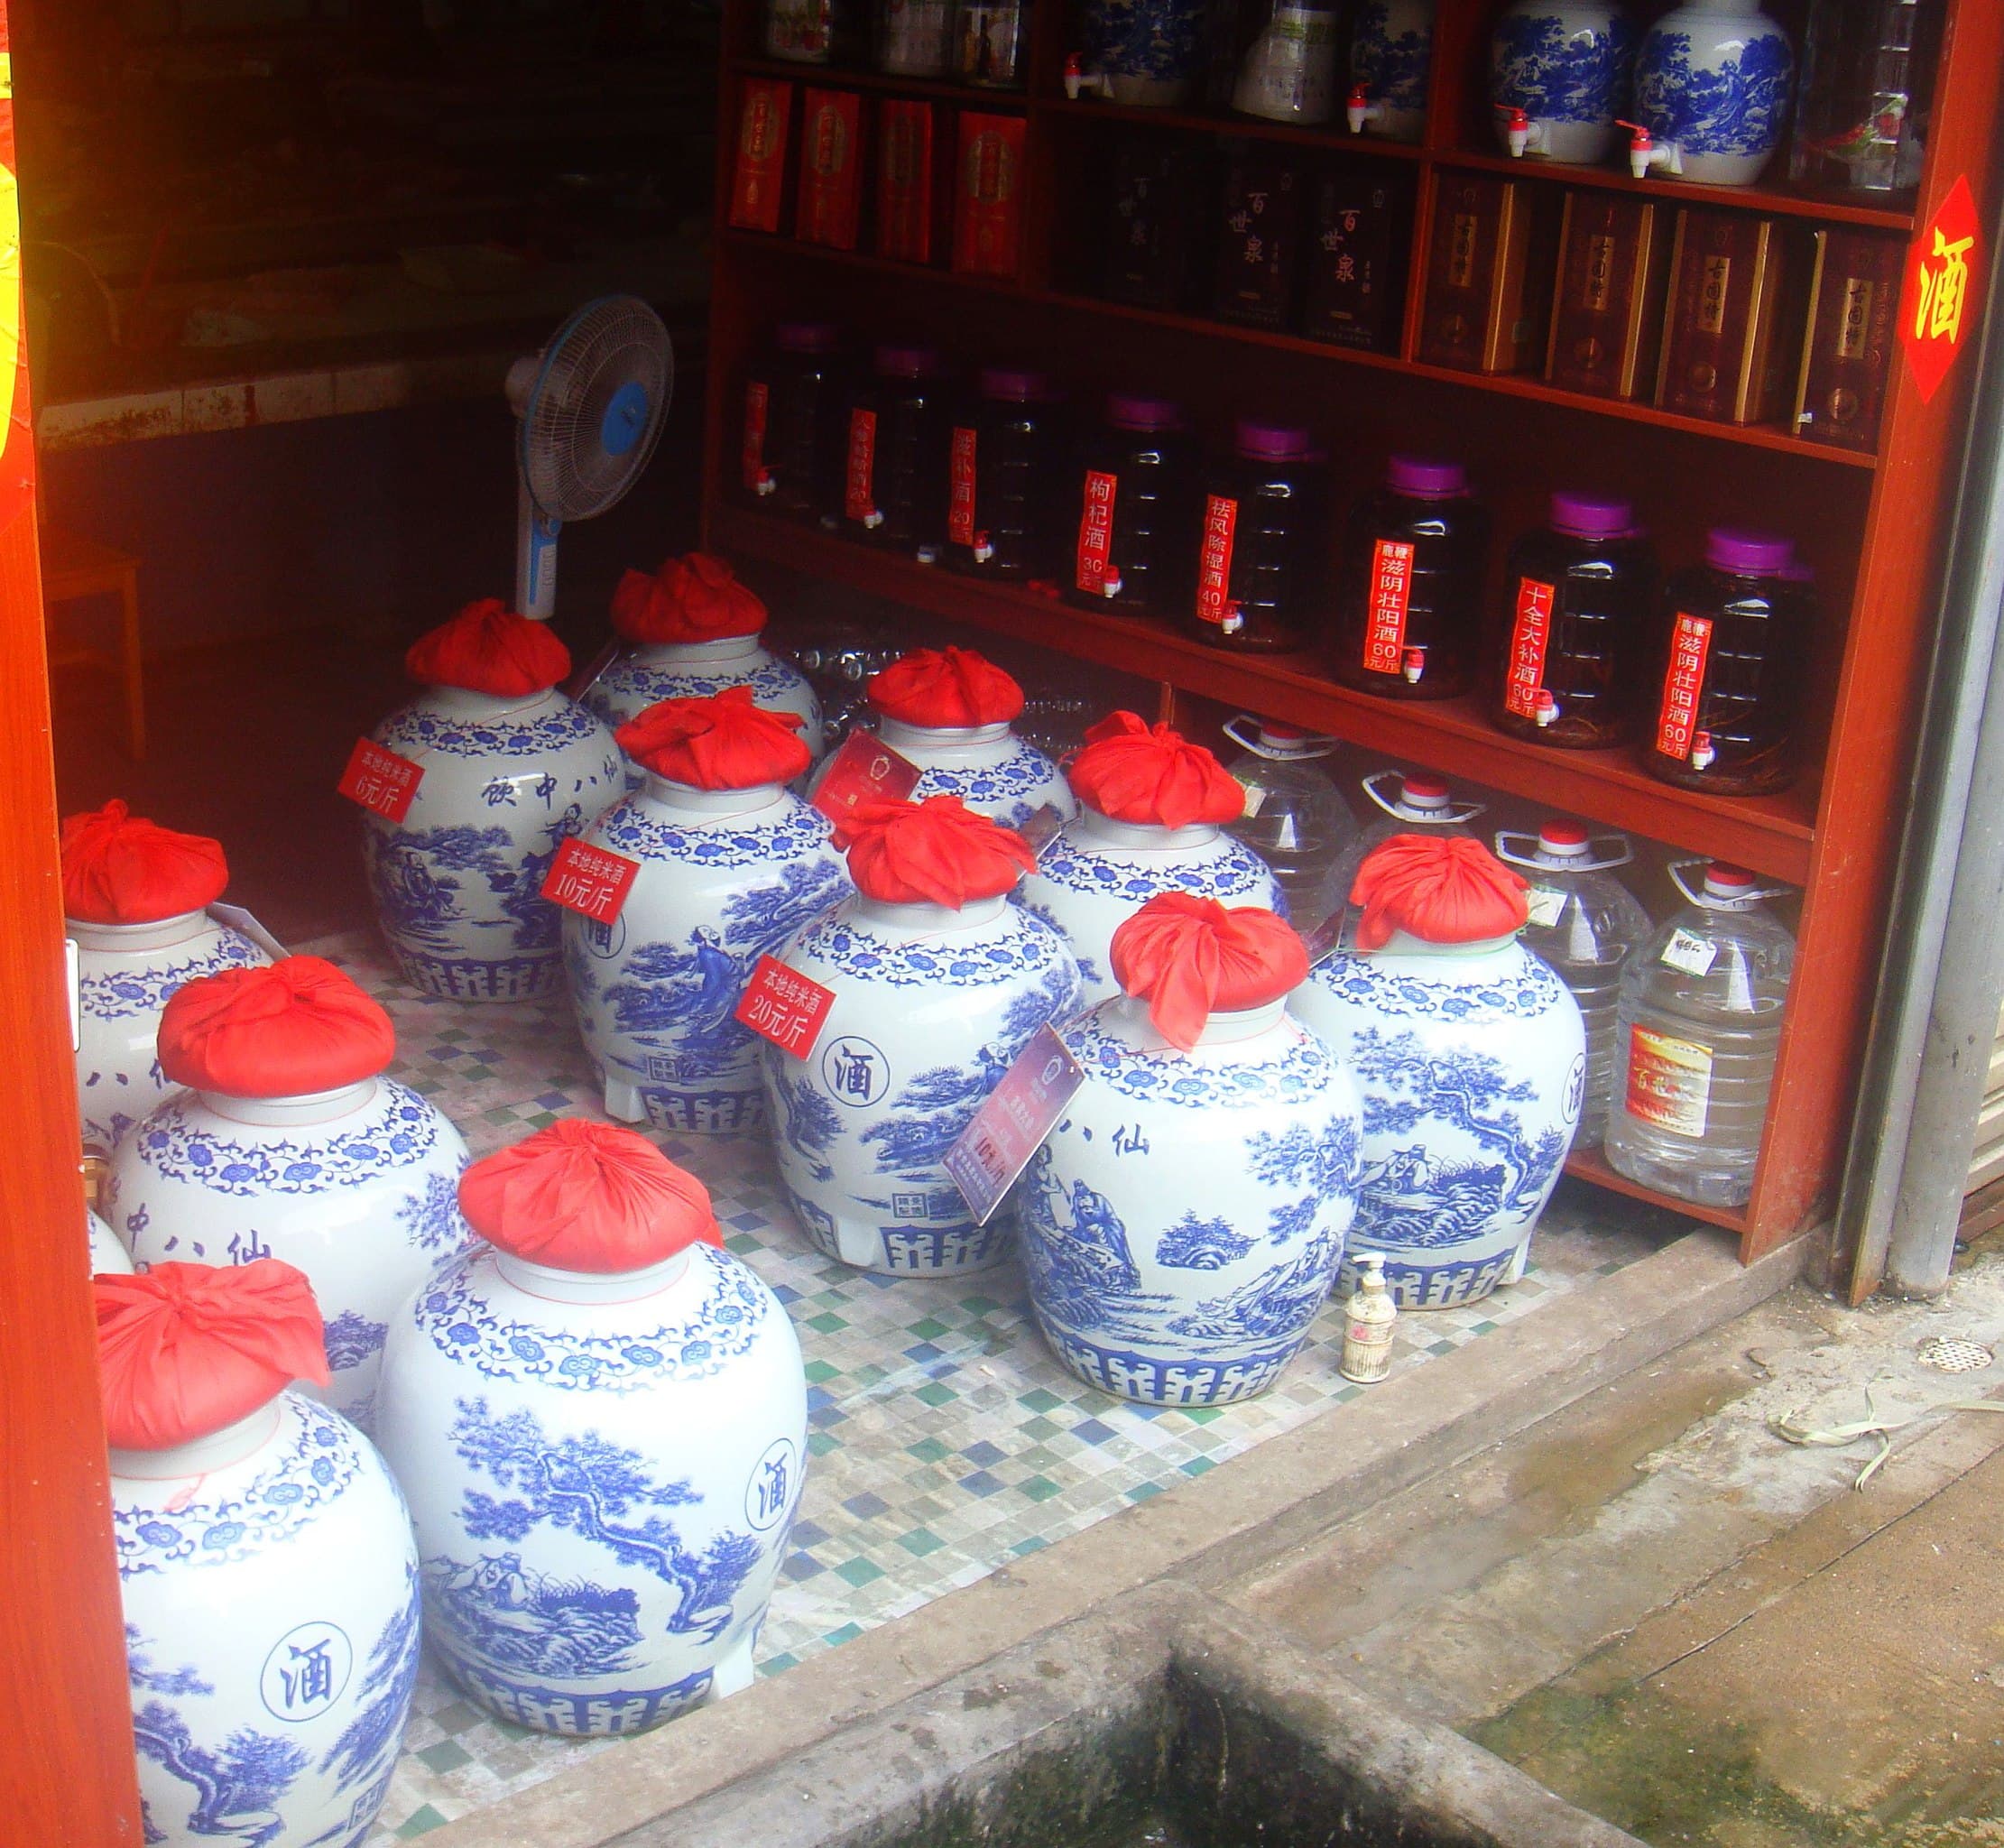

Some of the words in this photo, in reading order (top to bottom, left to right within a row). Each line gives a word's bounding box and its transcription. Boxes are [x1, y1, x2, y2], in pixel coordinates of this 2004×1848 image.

[1228, 191, 1269, 264] 百世泉
[1319, 208, 1361, 282] 百世泉
[1916, 226, 1974, 345] 酒
[953, 512, 970, 524] 20
[1085, 478, 1111, 551] 枸杞酒
[1205, 499, 1231, 588] 祛风除湿酒
[1202, 590, 1221, 605] 40
[1373, 559, 1406, 643] 滋阴壮阳酒
[1372, 643, 1397, 659] 60
[1515, 587, 1547, 686] 十全大补酒
[1370, 656, 1397, 671] 元/斤
[1667, 634, 1703, 725] 滋阴壮阳酒
[1512, 684, 1535, 702] 60
[1664, 724, 1686, 743] 60
[356, 775, 400, 814] 6元/斤
[361, 750, 413, 788] 本地纯米酒
[567, 847, 627, 885] 本地纯米酒
[554, 873, 614, 916] 10元/斤
[762, 968, 823, 1016] 本地纯米酒
[747, 994, 808, 1049] 20元/斤
[834, 1043, 874, 1101] 酒
[1058, 1118, 1150, 1158] 八仙
[758, 1451, 788, 1520] 酒
[280, 1637, 332, 1711] 酒
